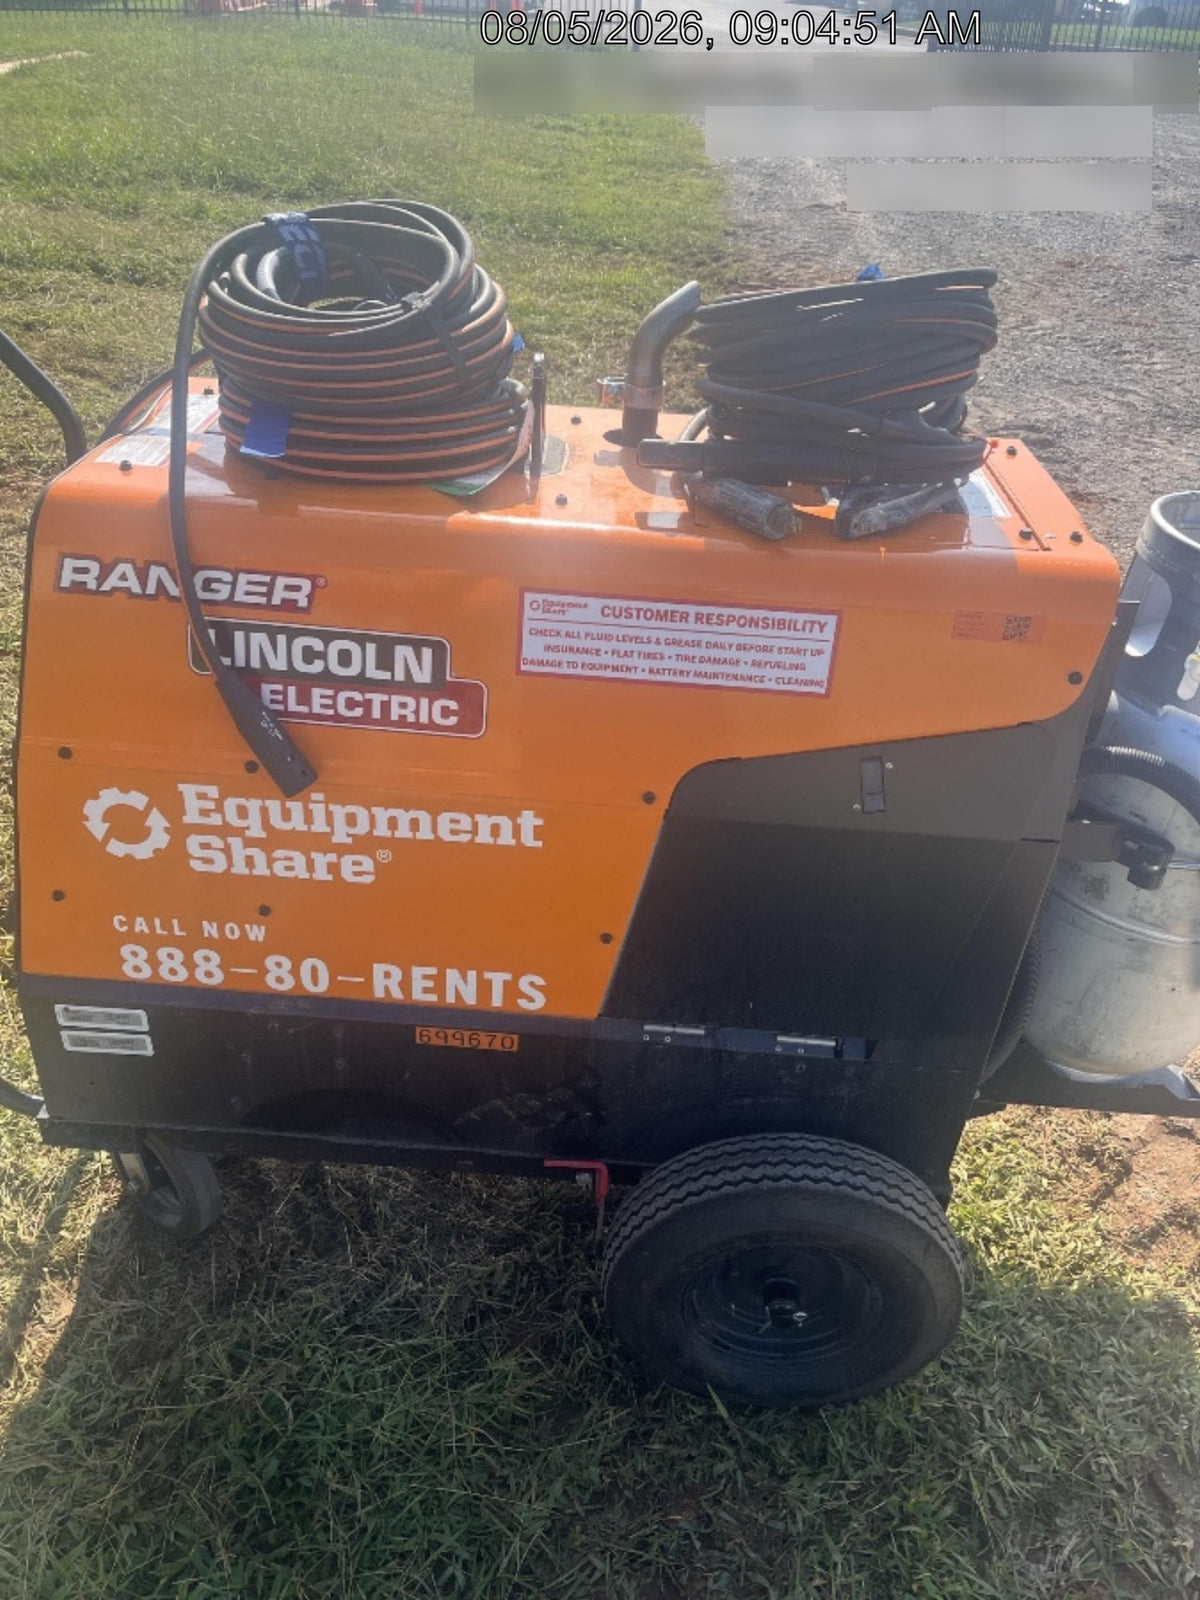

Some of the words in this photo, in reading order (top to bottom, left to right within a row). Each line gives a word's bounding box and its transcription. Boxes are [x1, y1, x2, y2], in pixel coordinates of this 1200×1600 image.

[600, 604, 691, 624] CUSTOMER
[694, 611, 828, 634] RESPONSIBILITY
[529, 626, 562, 638] CHECK
[564, 630, 581, 640] ALL
[616, 633, 652, 645] LEVELS
[664, 637, 703, 650] GREASE
[735, 643, 776, 654] BEFORE
[810, 648, 825, 657] UP
[543, 644, 602, 657] INSURANCE
[611, 649, 635, 659] FLAT
[637, 651, 666, 661] TIRES
[698, 655, 741, 667] DAMAGE
[522, 657, 563, 669] DAMAGE
[566, 660, 579, 670] TO
[693, 671, 766, 684] MAINTENANCE
[261, 683, 459, 726] ELECTRIC
[177, 783, 545, 849] Equipment
[112, 914, 188, 936] CALL
[201, 919, 267, 942] NOW
[419, 1028, 515, 1051] 699670
